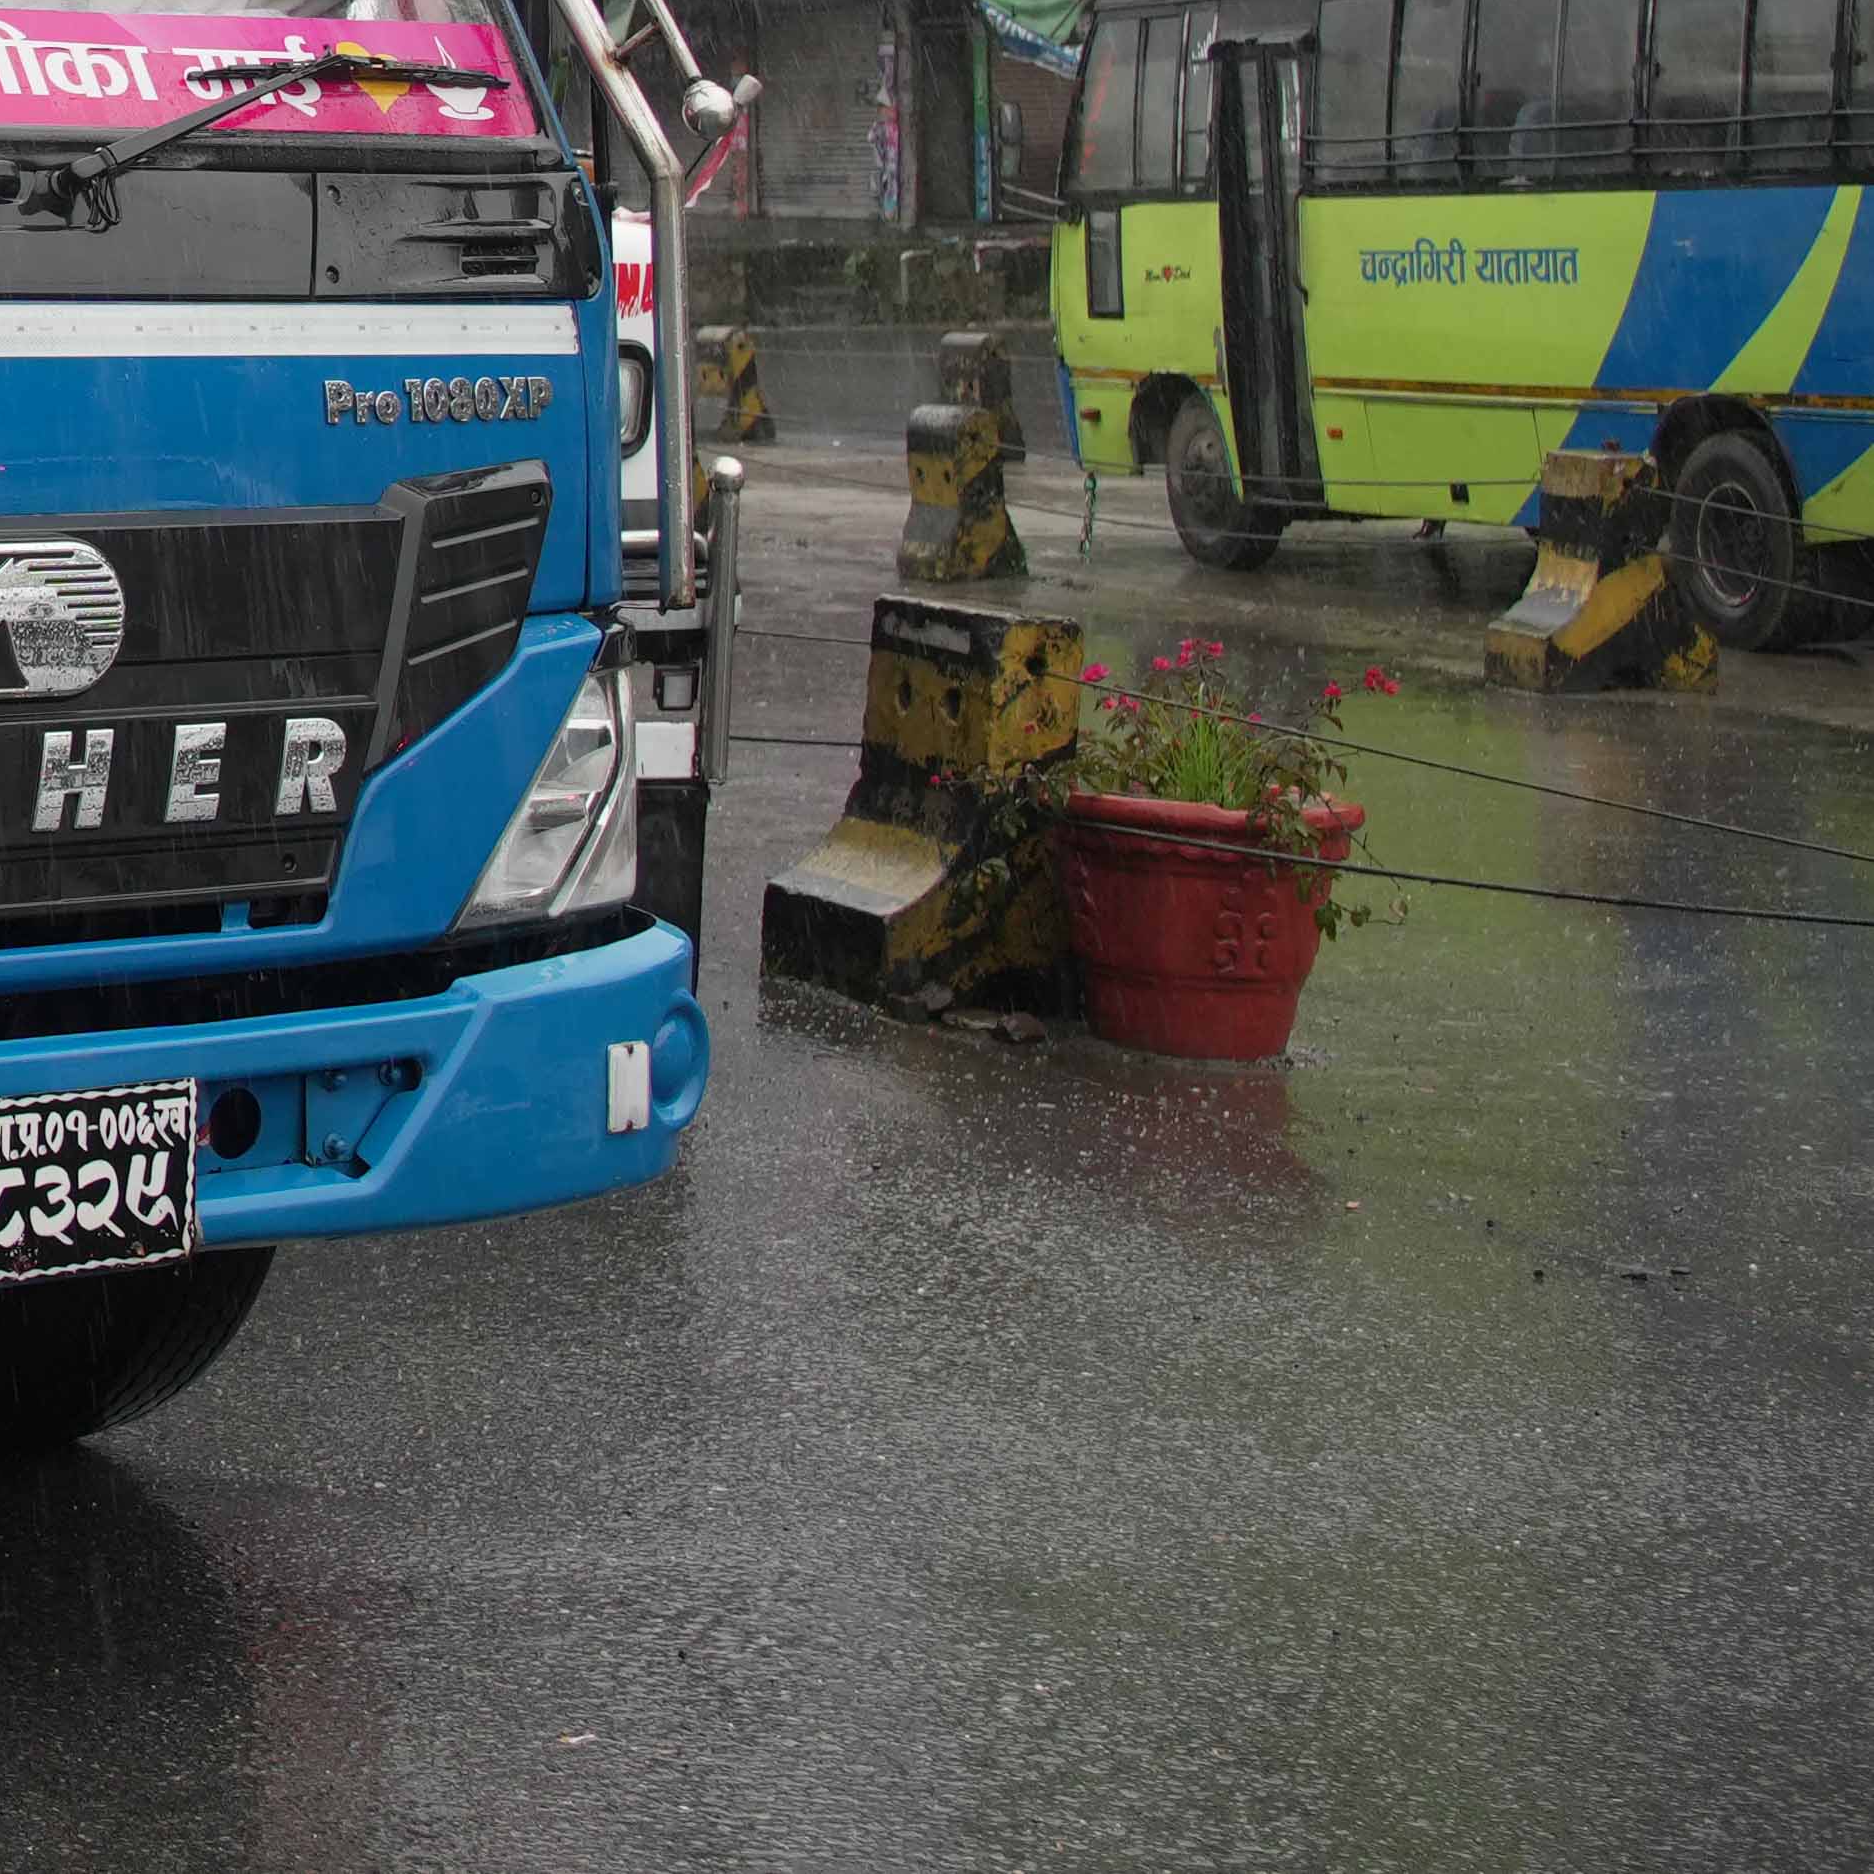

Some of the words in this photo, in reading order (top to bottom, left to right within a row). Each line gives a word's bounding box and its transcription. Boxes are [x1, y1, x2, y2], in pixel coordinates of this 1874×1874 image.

[1359, 237, 1466, 288] चन्द्रागिरी
[1474, 246, 1579, 285] यातायात
[324, 379, 402, 425] Pro
